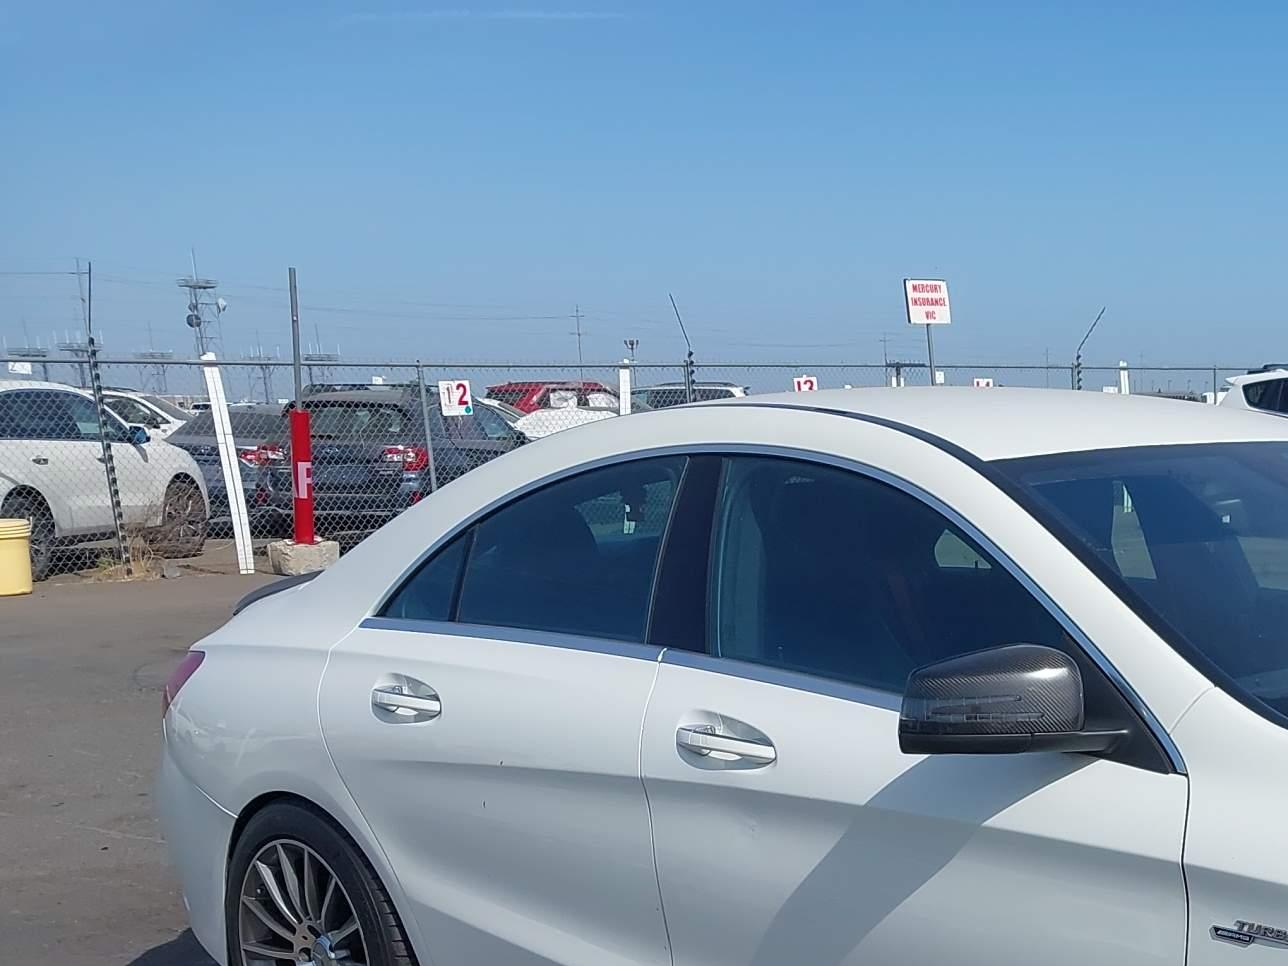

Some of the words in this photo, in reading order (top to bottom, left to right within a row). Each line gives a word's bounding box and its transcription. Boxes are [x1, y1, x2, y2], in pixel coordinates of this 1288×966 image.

[912, 284, 942, 293] MERCURY
[911, 297, 946, 306] INSURANCE
[446, 383, 468, 405] 12
